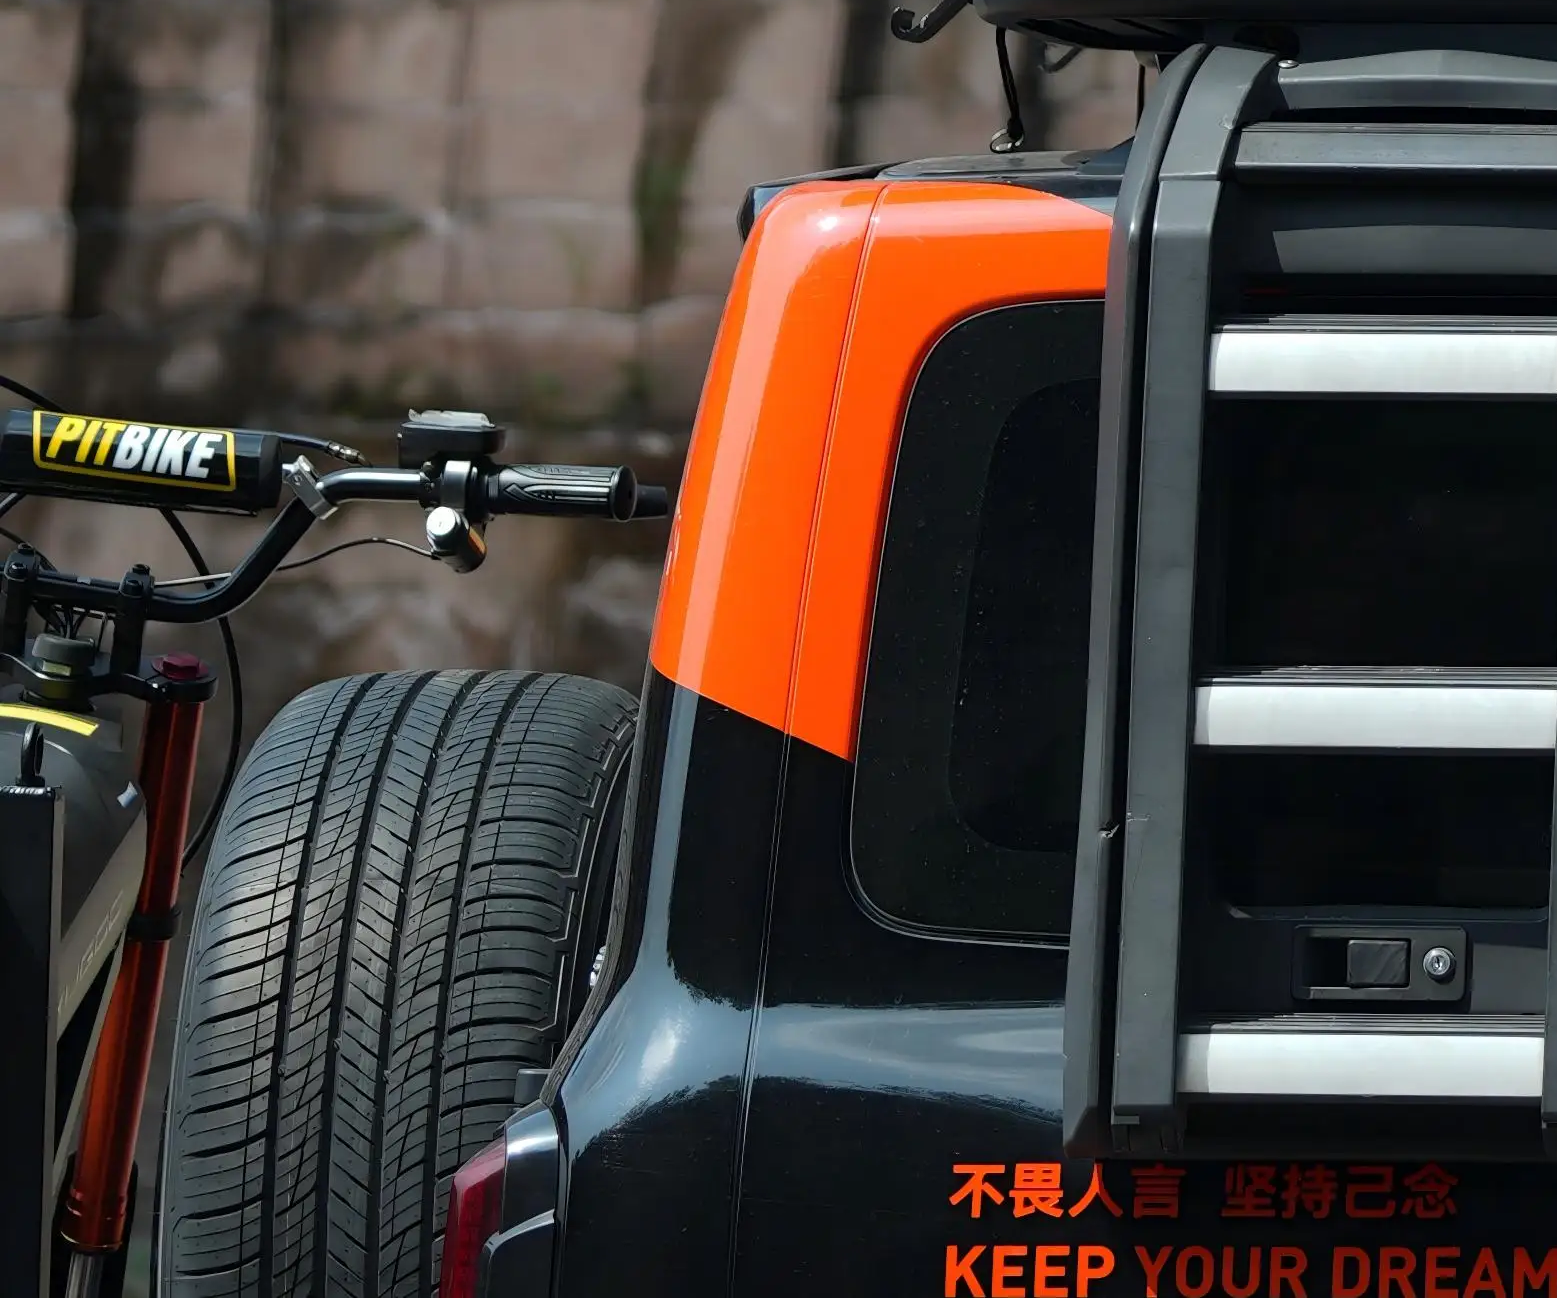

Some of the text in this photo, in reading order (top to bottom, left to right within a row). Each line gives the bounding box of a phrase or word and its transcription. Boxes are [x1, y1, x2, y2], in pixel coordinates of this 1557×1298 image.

[46, 416, 223, 479] PITBIKE
[948, 1161, 1459, 1220] 不畏人言 坚持己念
[944, 1244, 1116, 1298] KEEP
[1134, 1245, 1308, 1298] YOUR
